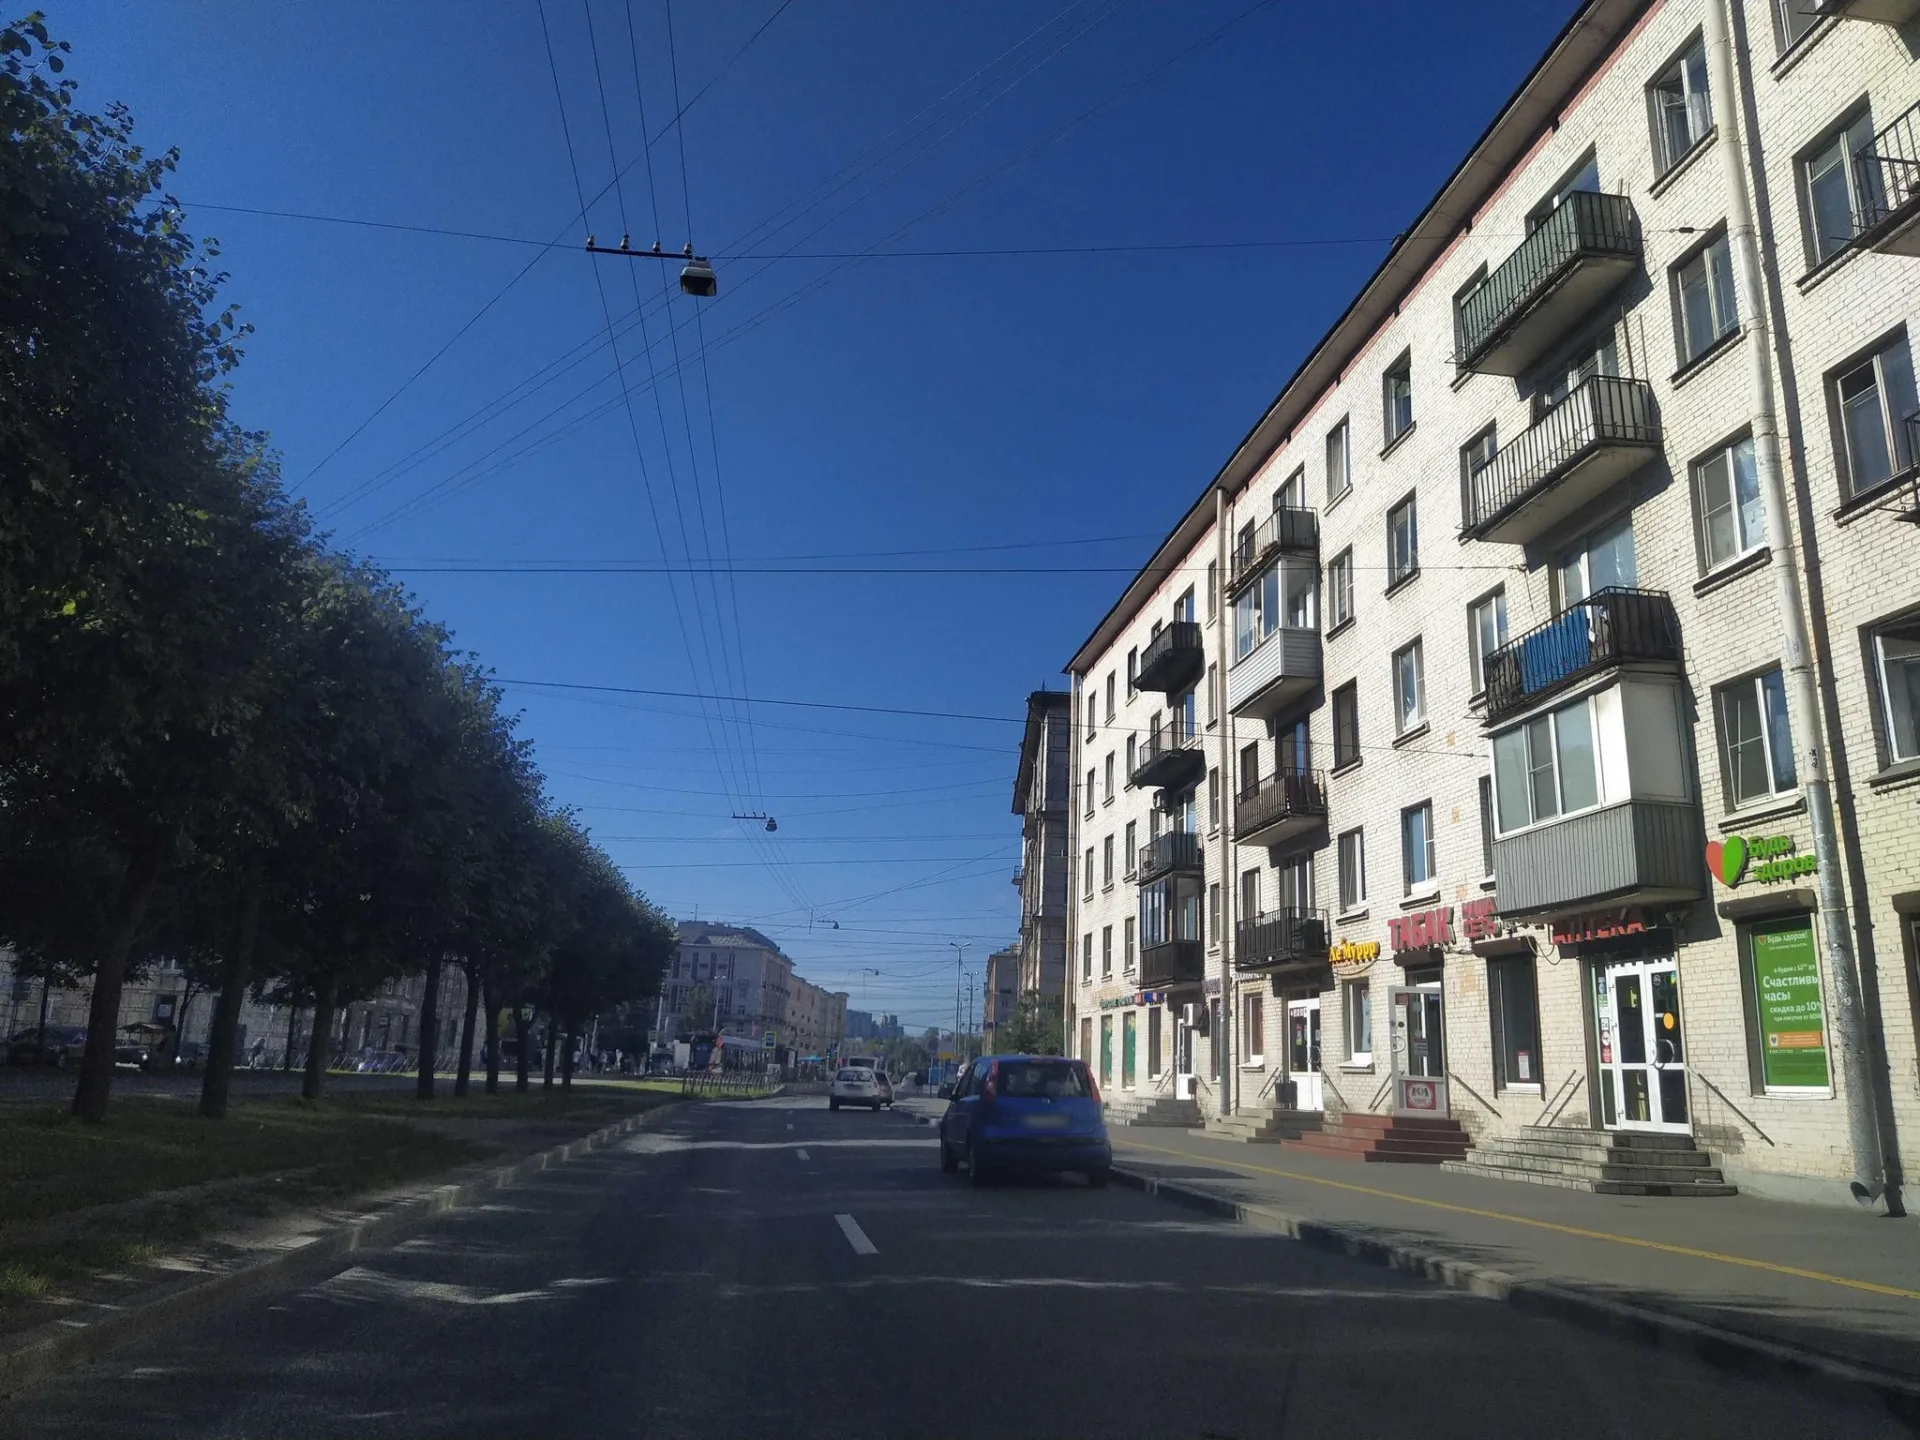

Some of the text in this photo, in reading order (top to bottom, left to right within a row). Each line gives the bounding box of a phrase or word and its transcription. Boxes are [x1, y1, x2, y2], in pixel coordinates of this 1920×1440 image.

[1748, 835, 1790, 860] Будь
[1753, 854, 1817, 882] здоров
[1388, 906, 1454, 950] ТАБАК
[1764, 991, 1791, 1001] часы
[1796, 1005, 1805, 1013] до
